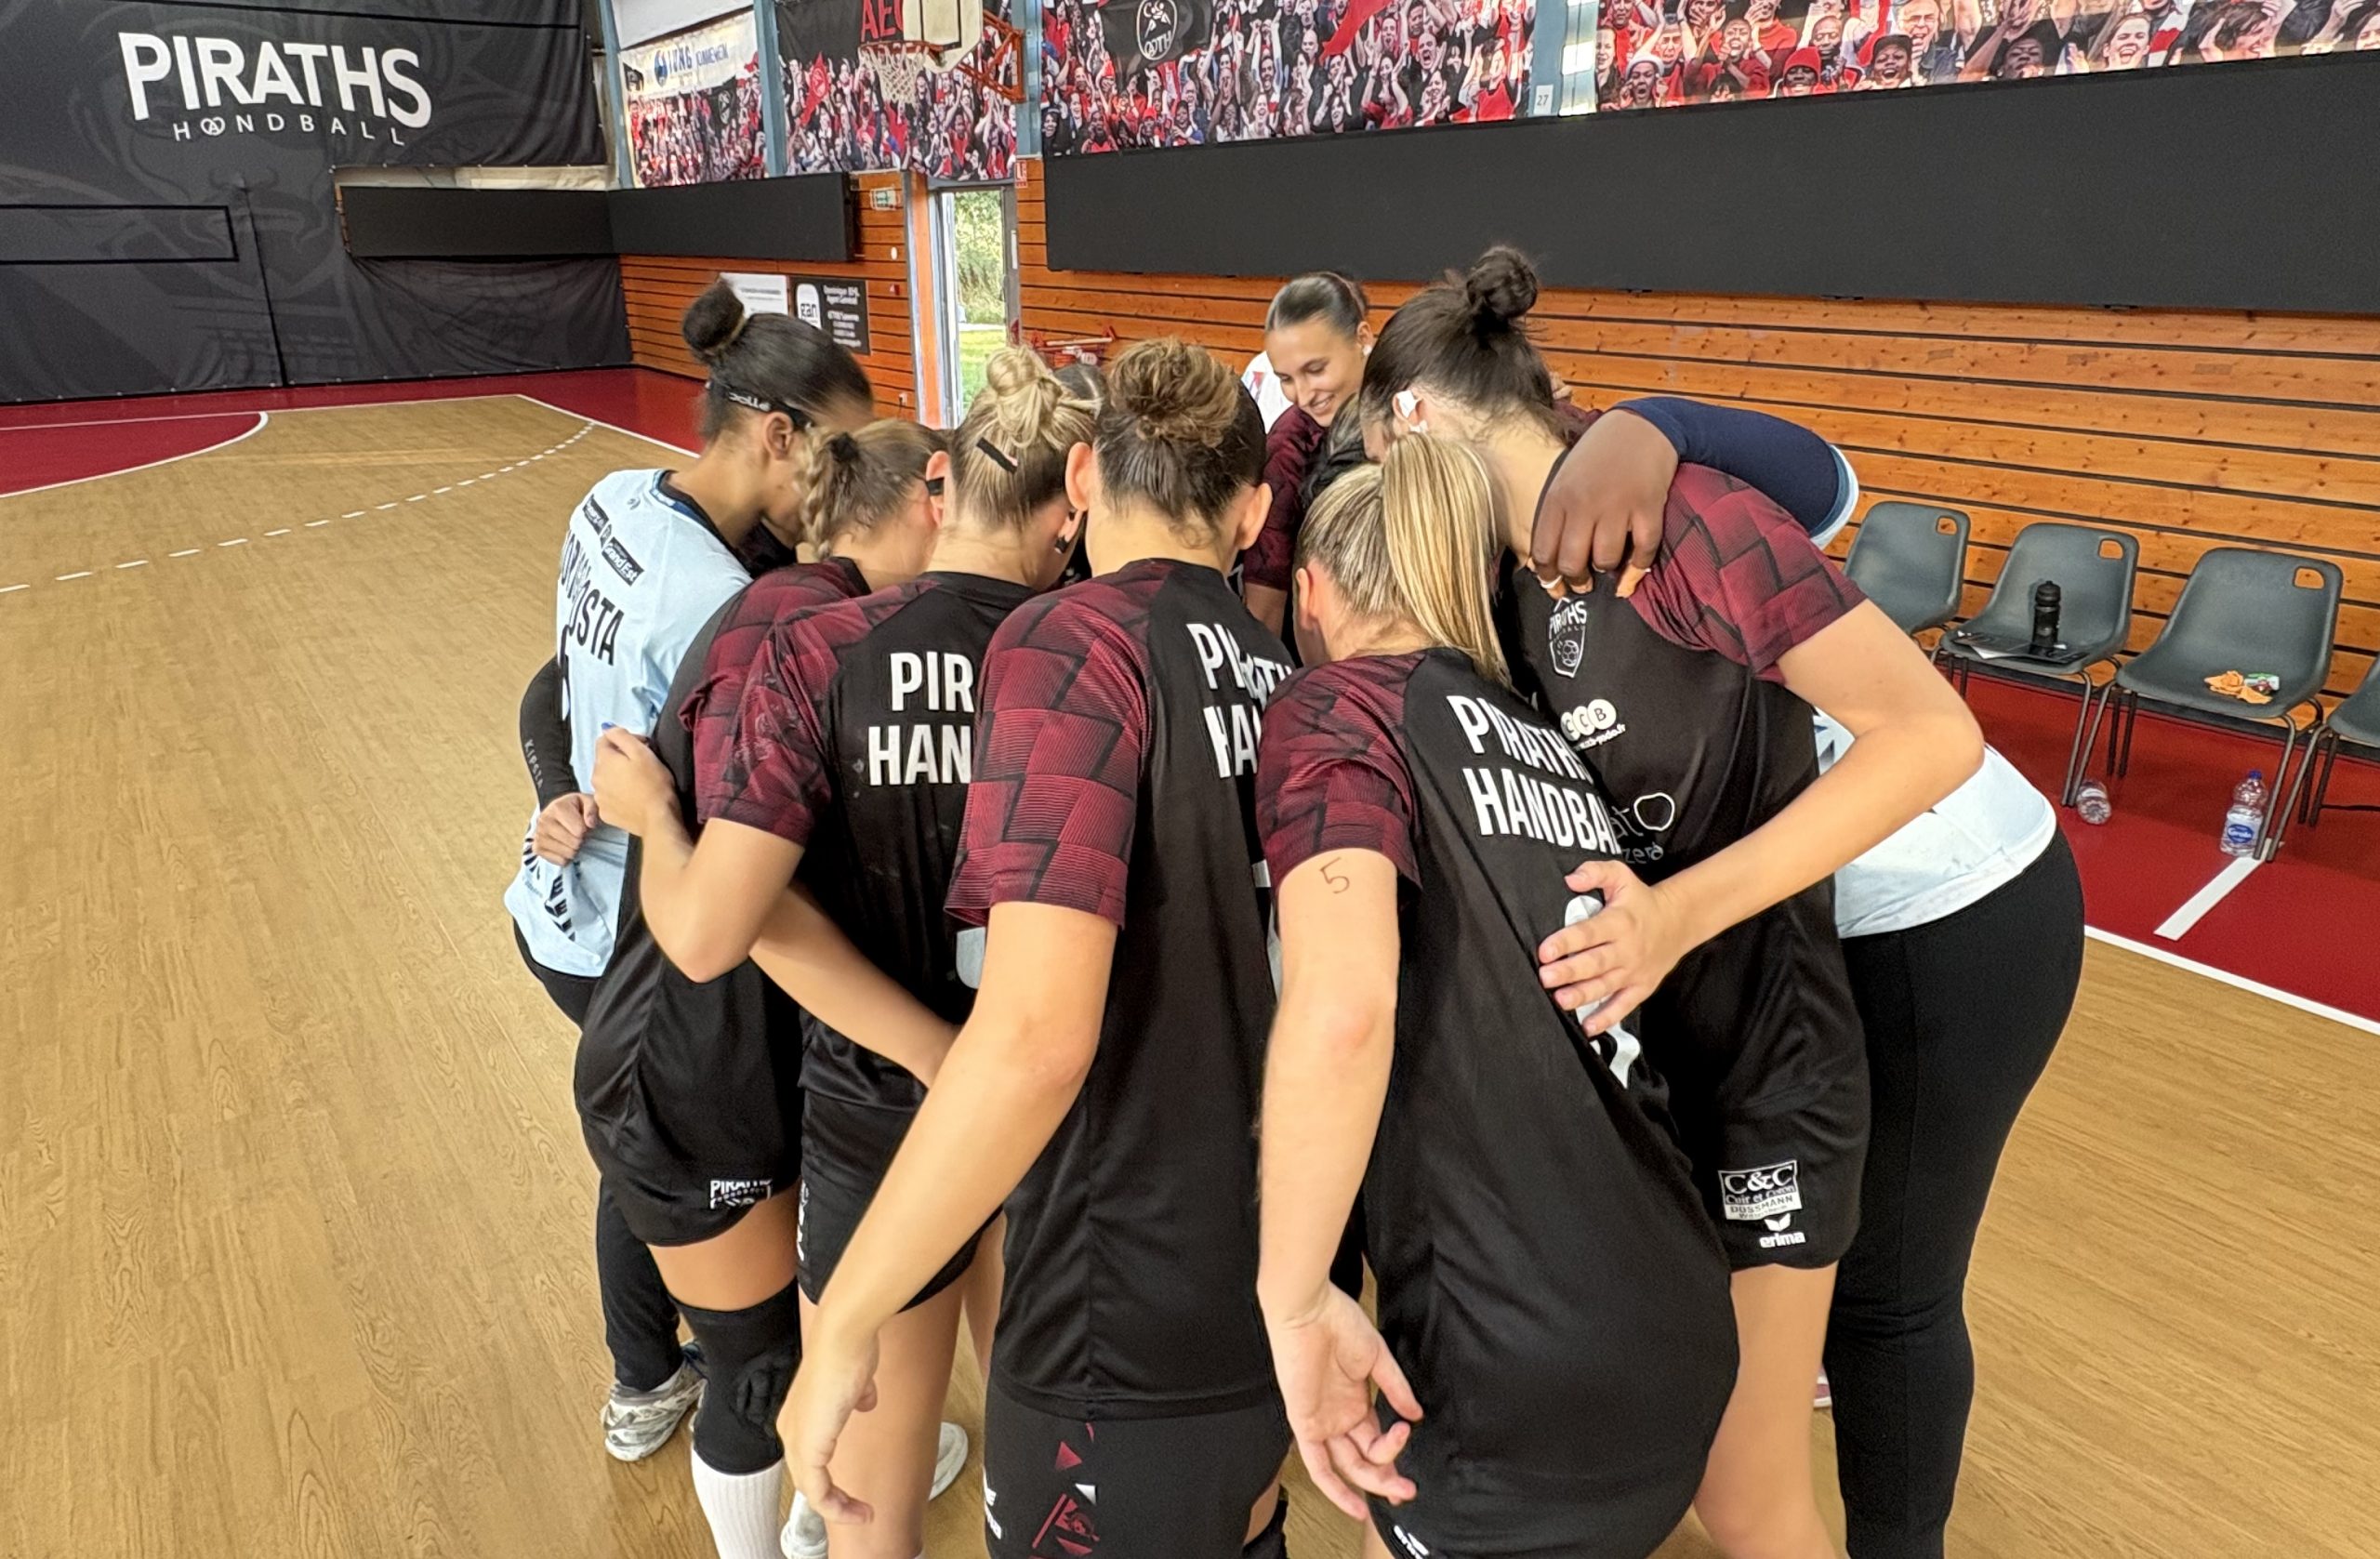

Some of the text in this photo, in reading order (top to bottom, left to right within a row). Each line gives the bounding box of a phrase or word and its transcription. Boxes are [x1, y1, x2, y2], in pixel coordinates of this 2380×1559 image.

[118, 32, 432, 128] PIRATHS
[1537, 94, 1549, 106] 27
[890, 651, 975, 713] PIR
[867, 723, 972, 786] HAN
[1319, 856, 1350, 894] 5
[1725, 1165, 1792, 1195] C&C
[1726, 1194, 1752, 1206] Cuir
[1759, 1232, 1806, 1249] erima
